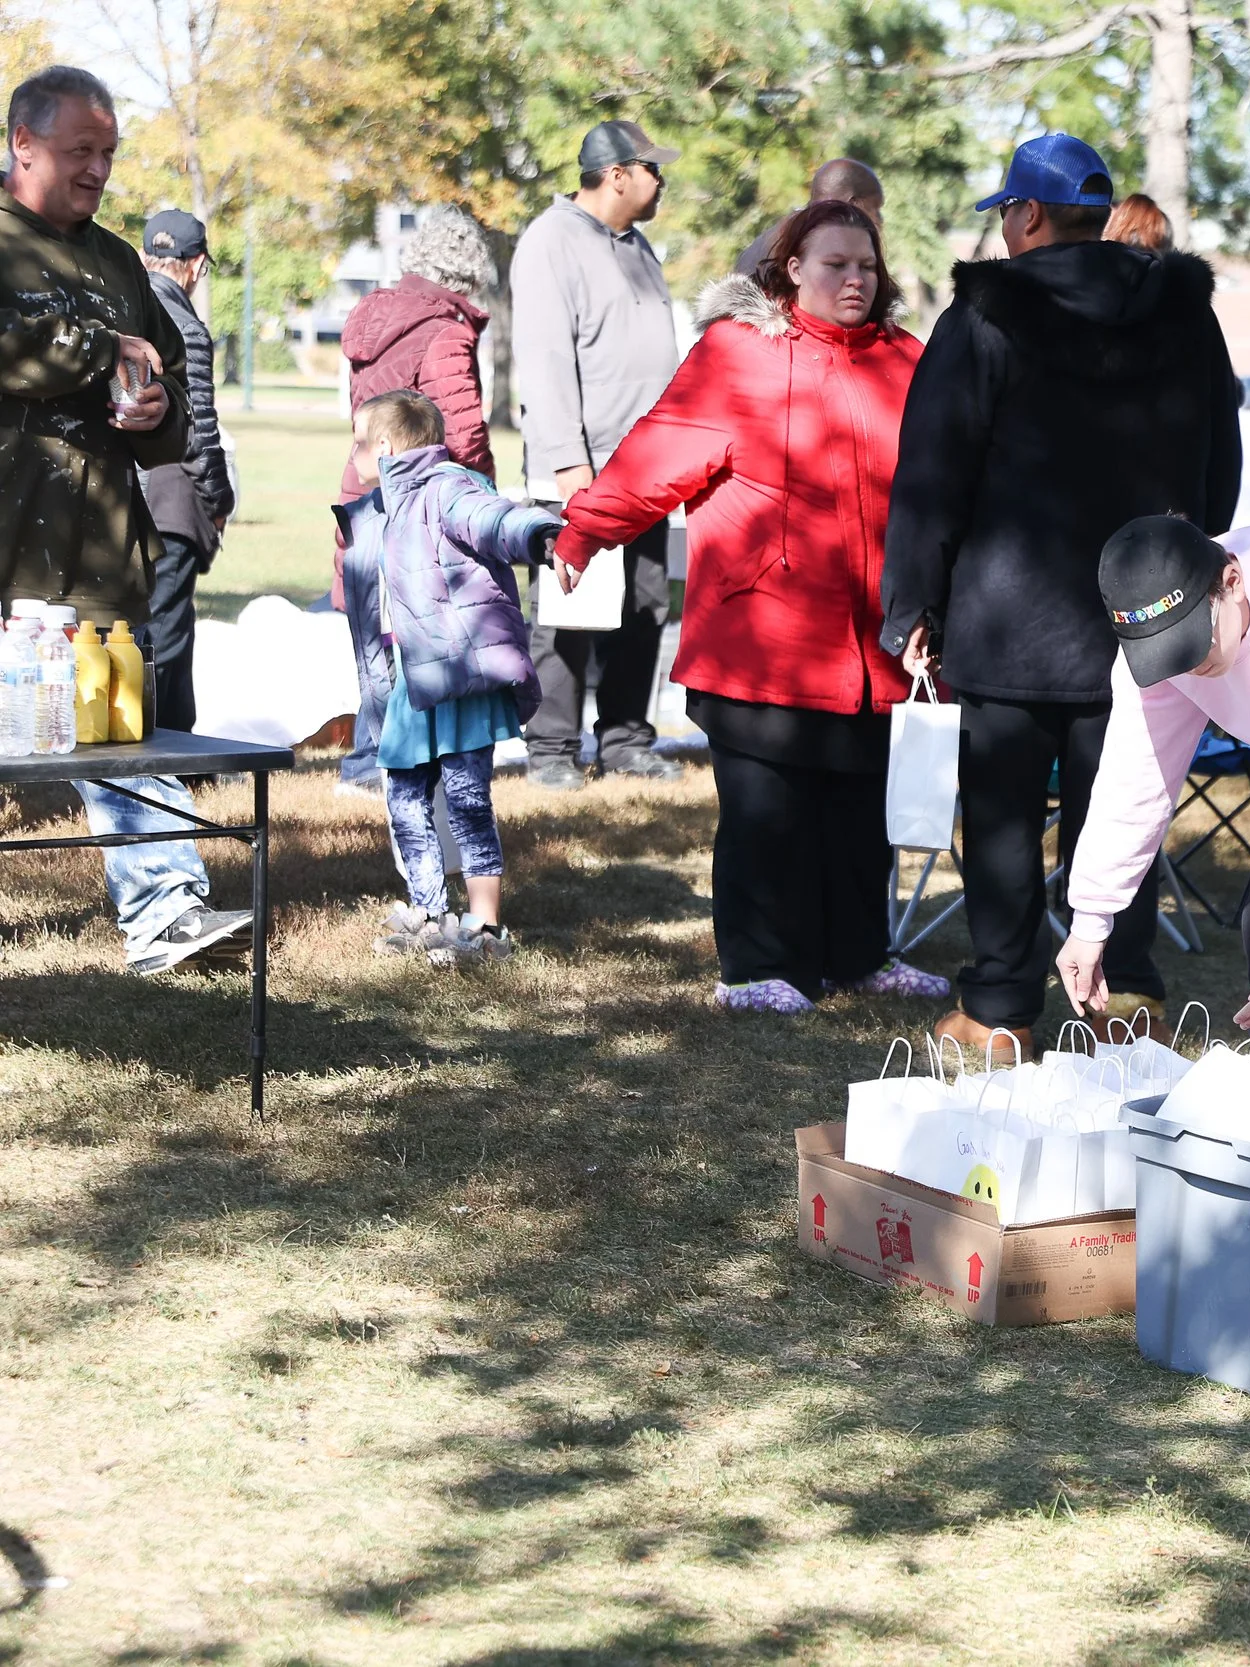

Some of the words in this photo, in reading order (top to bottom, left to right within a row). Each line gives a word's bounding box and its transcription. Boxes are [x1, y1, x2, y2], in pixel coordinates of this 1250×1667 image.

[814, 1227, 825, 1242] UP
[1070, 1237, 1077, 1248] A
[1079, 1234, 1110, 1247] Family
[1086, 1245, 1114, 1258] 00681
[967, 1288, 980, 1303] UP
